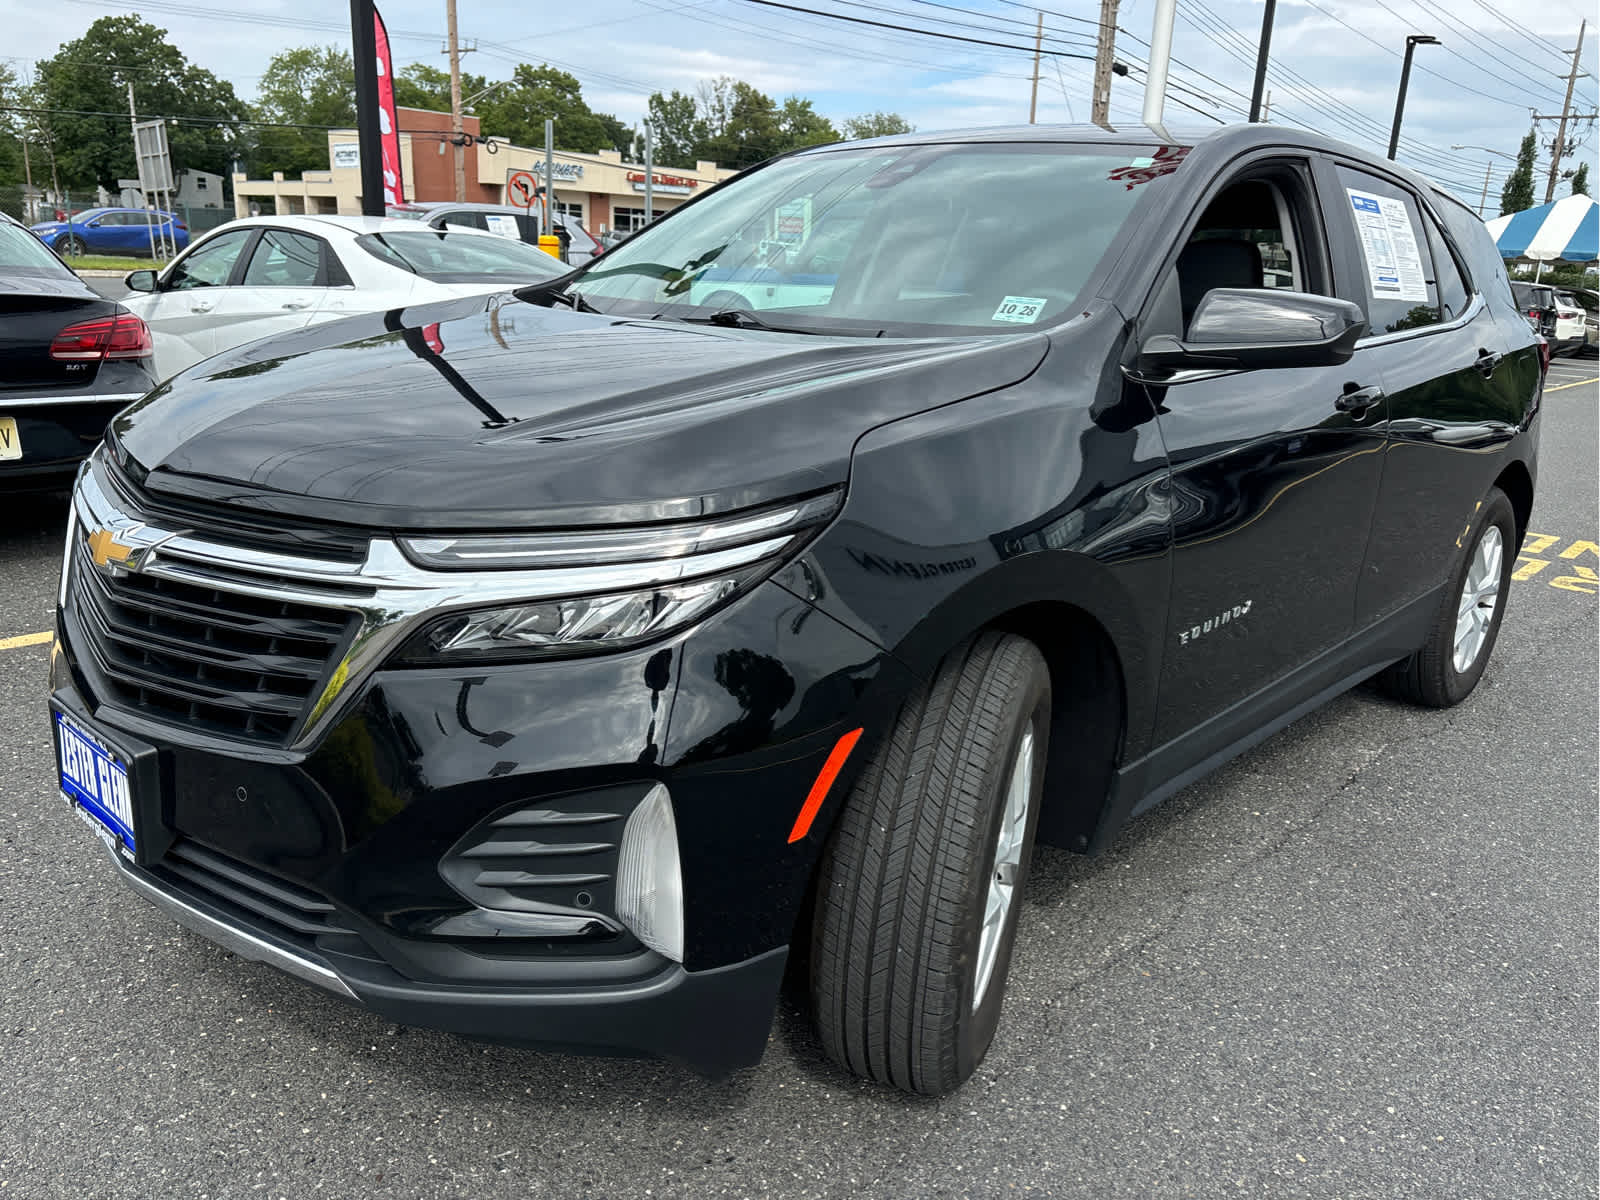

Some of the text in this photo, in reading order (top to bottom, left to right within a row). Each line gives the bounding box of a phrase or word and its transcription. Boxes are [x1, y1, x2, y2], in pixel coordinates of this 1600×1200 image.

[999, 304, 1037, 316] 10 28
[59, 723, 99, 801] LESTER
[97, 755, 134, 832] GLENN
